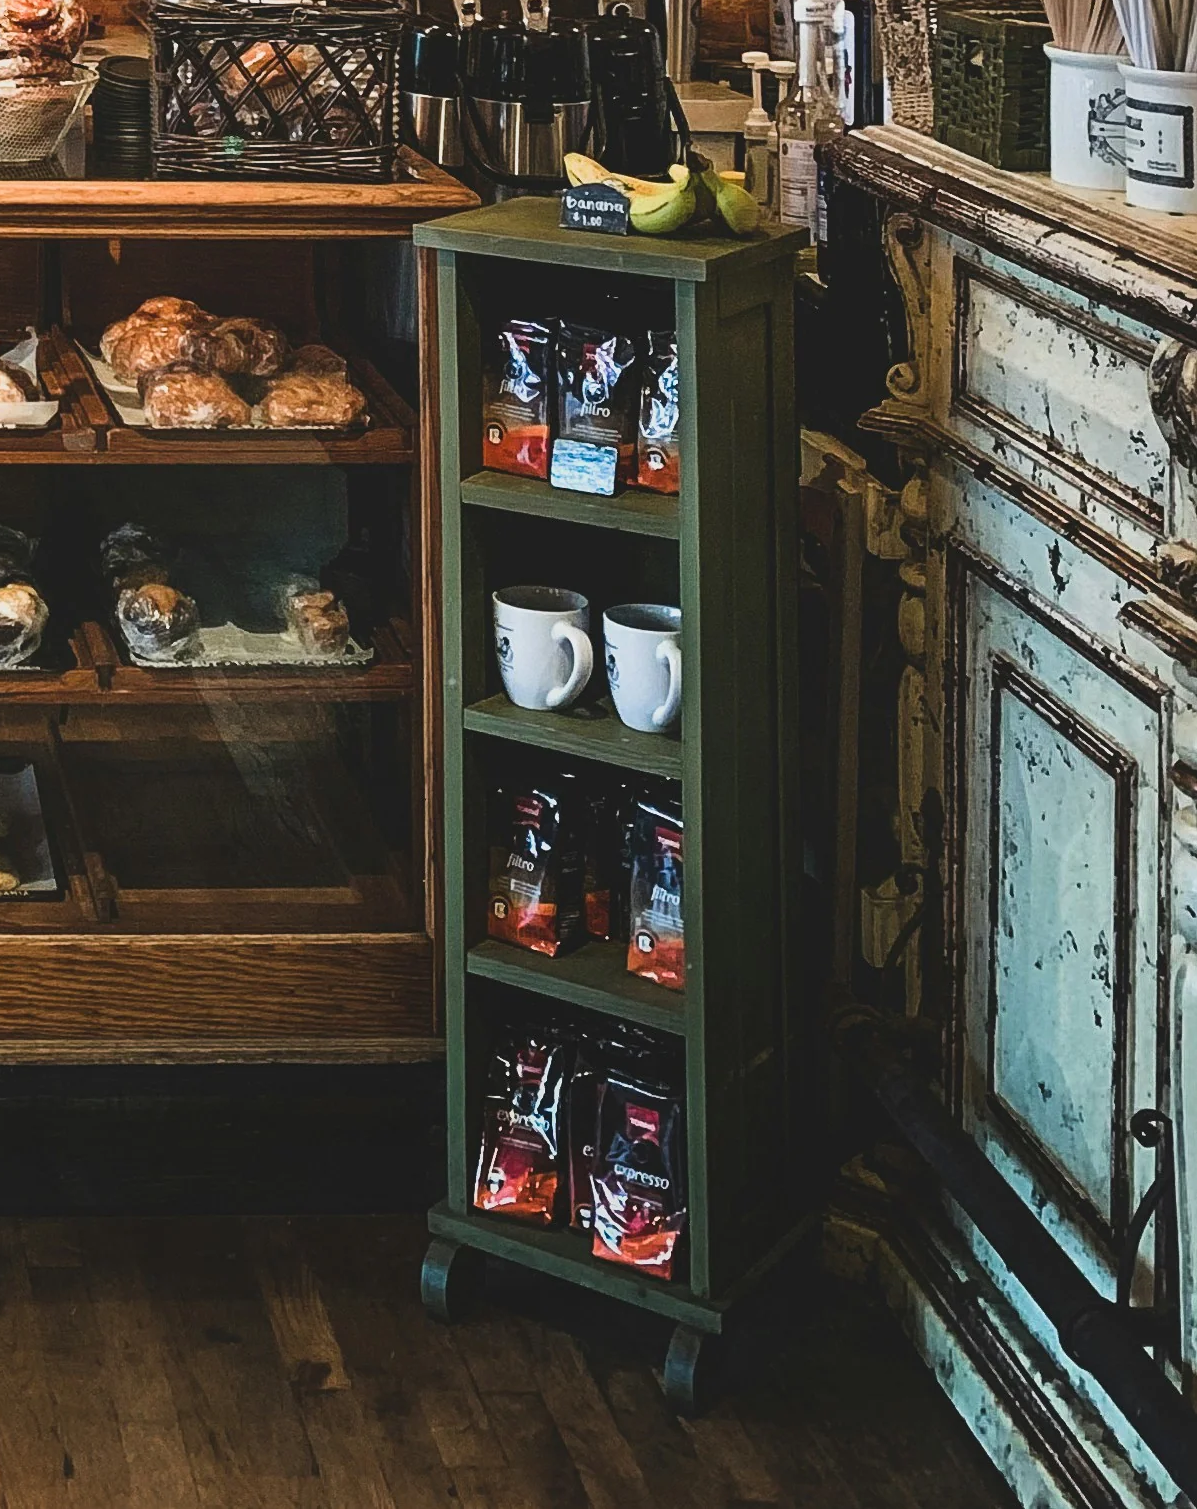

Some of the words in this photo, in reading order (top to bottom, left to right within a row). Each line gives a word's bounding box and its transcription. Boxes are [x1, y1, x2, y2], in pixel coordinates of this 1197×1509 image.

[565, 194, 625, 214] banana
[580, 401, 611, 419] filtro
[506, 852, 535, 873] filtro
[650, 883, 681, 906] filtro
